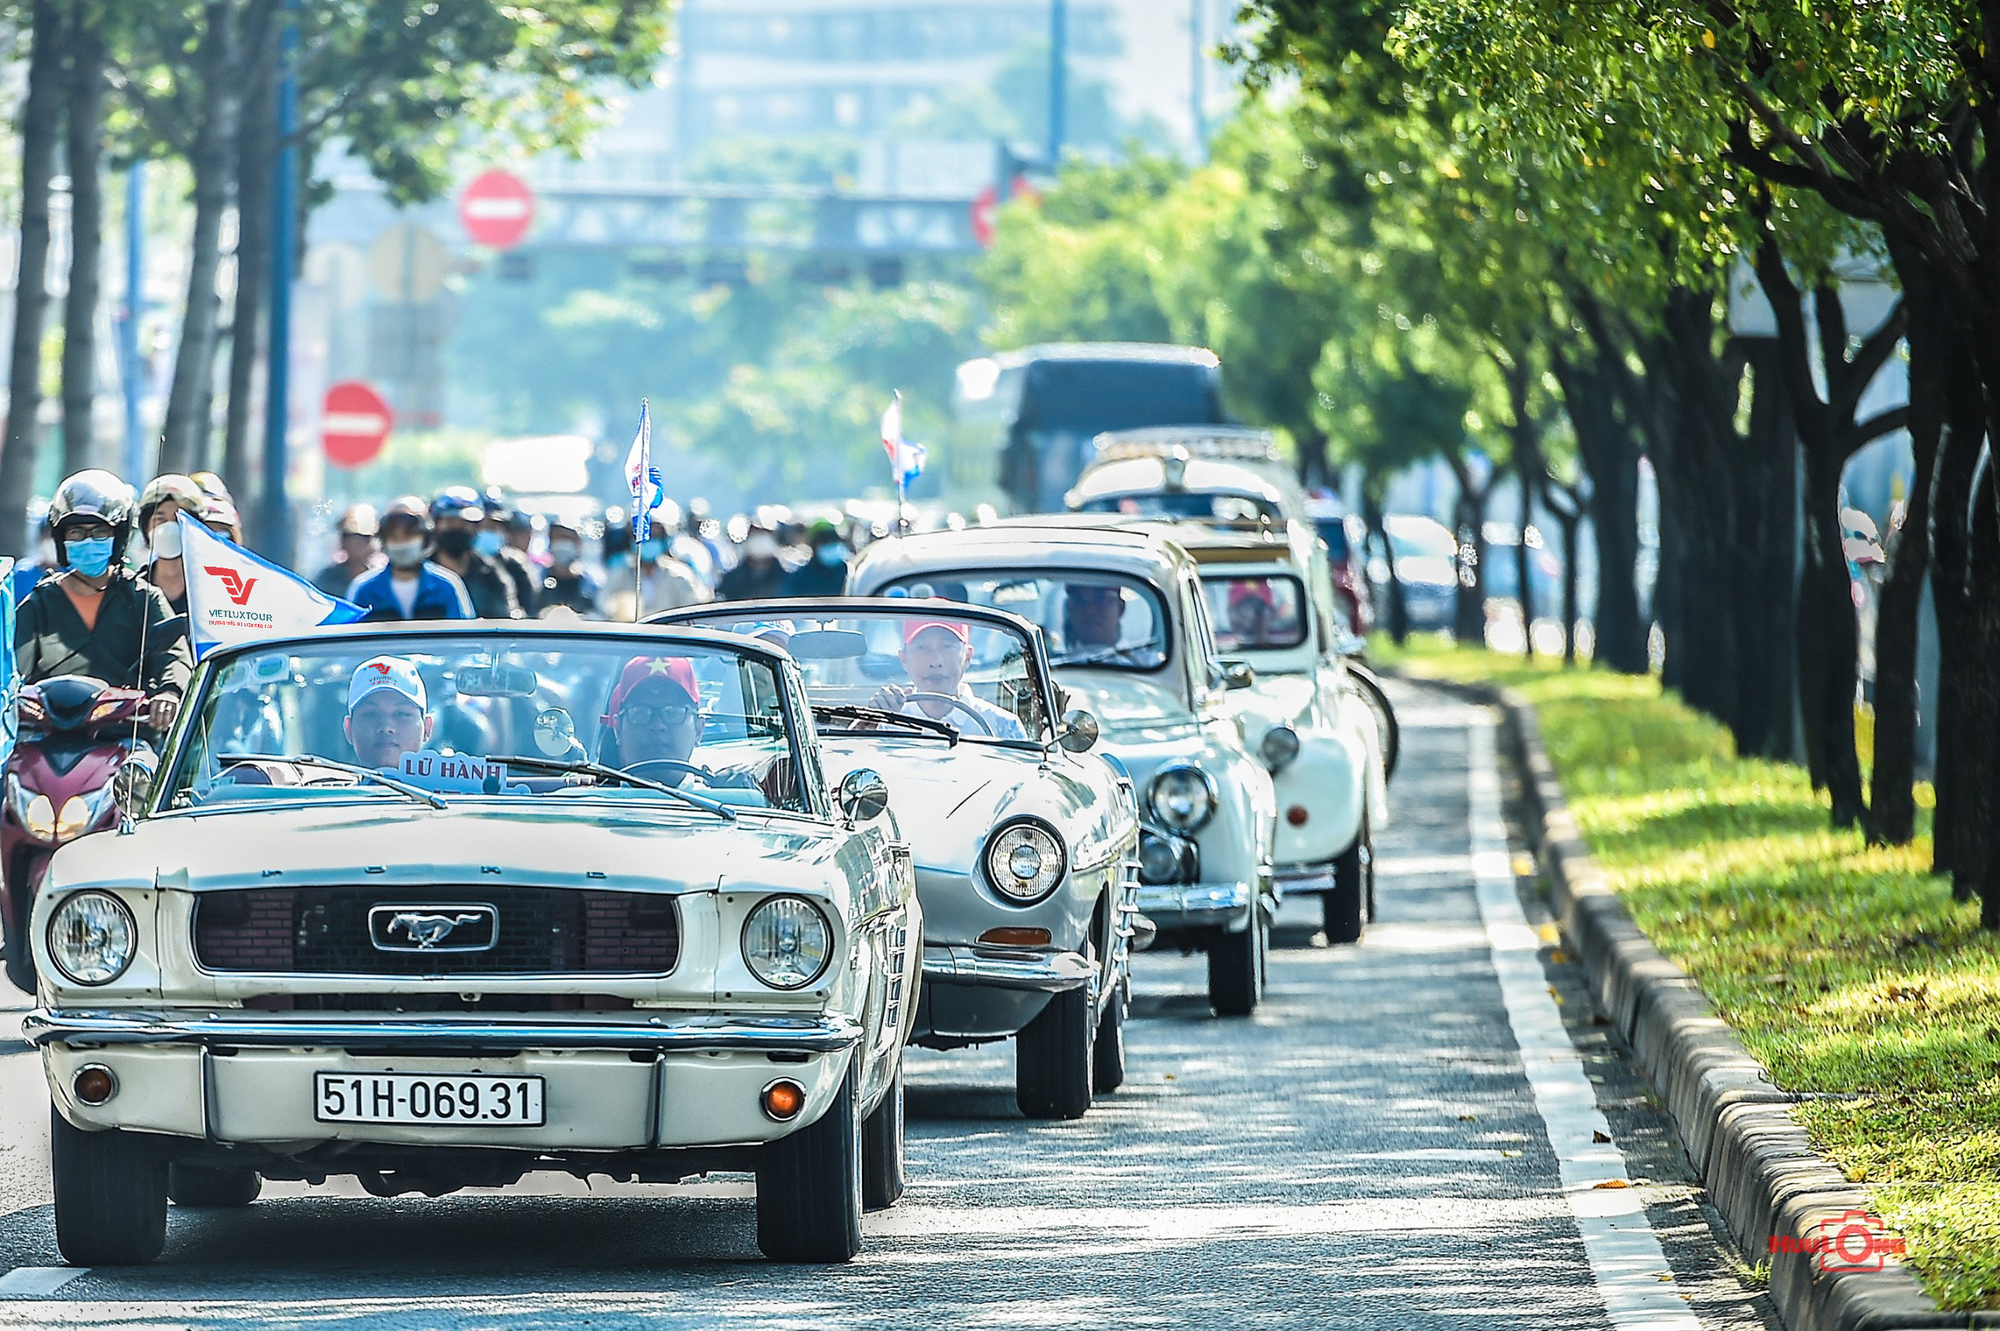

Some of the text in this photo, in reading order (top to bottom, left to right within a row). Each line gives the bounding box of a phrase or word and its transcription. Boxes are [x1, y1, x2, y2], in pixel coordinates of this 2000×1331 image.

[208, 609, 273, 622] VIETLUXTOUR
[440, 760, 501, 780] HÀNH
[323, 1078, 530, 1120] 51H-069.31
